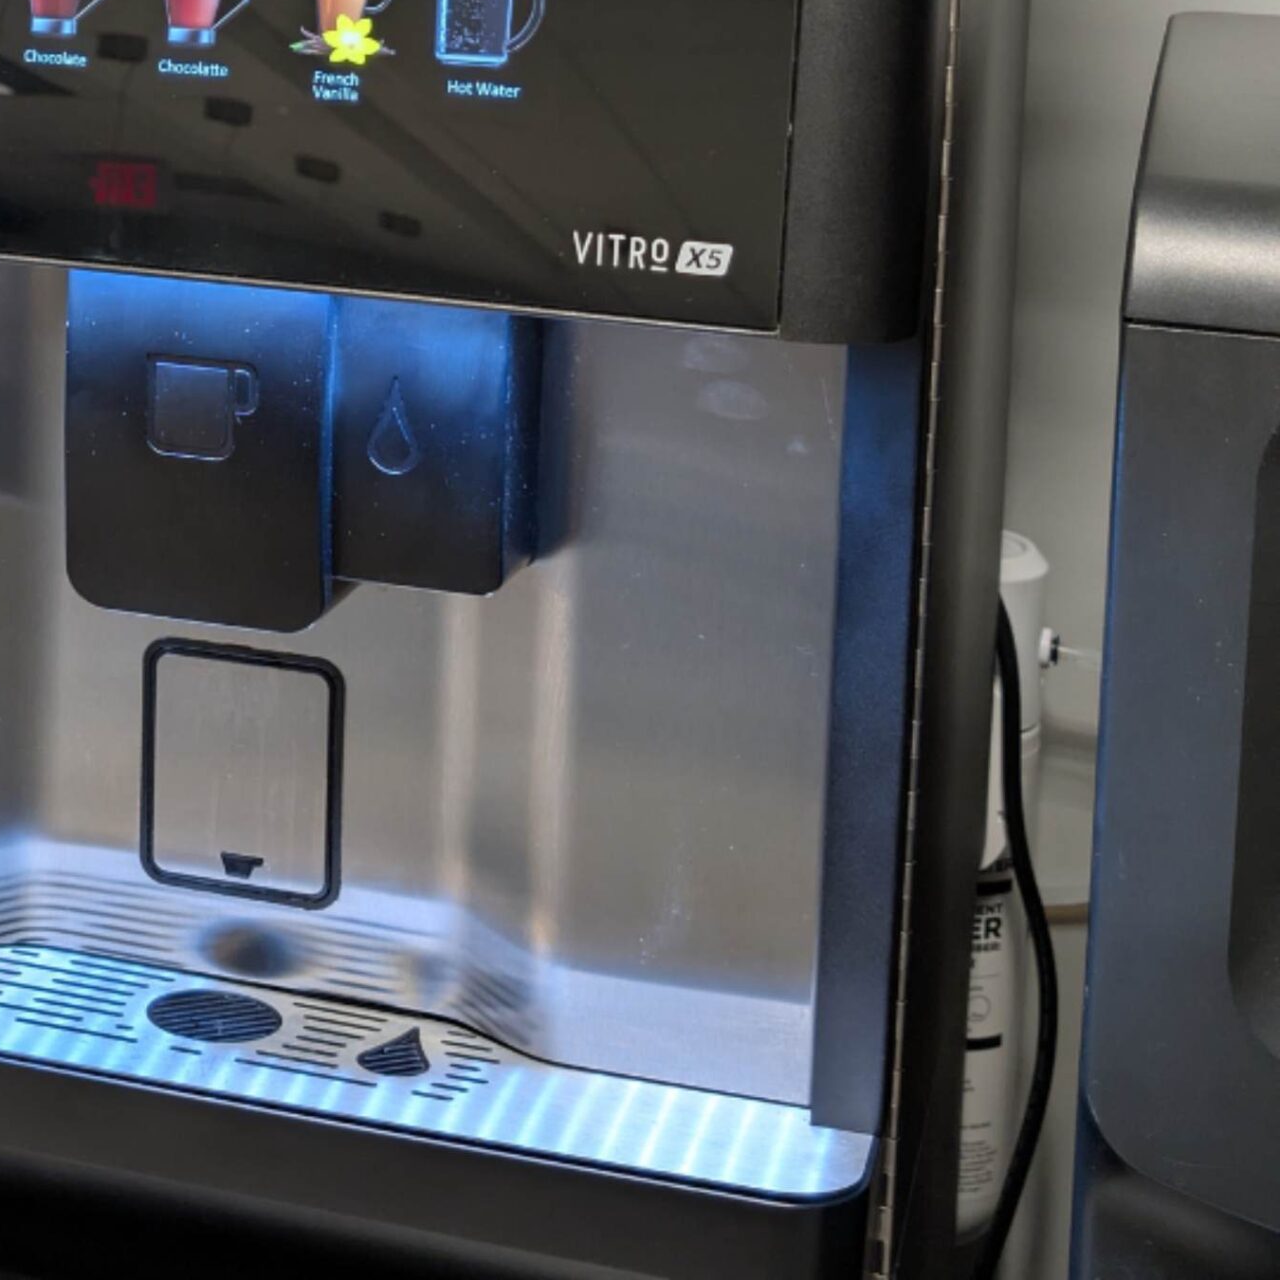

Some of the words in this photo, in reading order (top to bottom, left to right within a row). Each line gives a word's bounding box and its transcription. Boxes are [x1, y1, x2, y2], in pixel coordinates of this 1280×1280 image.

[312, 70, 360, 88] French
[446, 78, 473, 96] Hot
[474, 80, 522, 100] Water
[311, 84, 360, 103] Vanilla
[572, 229, 670, 273] VITRO
[684, 246, 724, 270] X5
